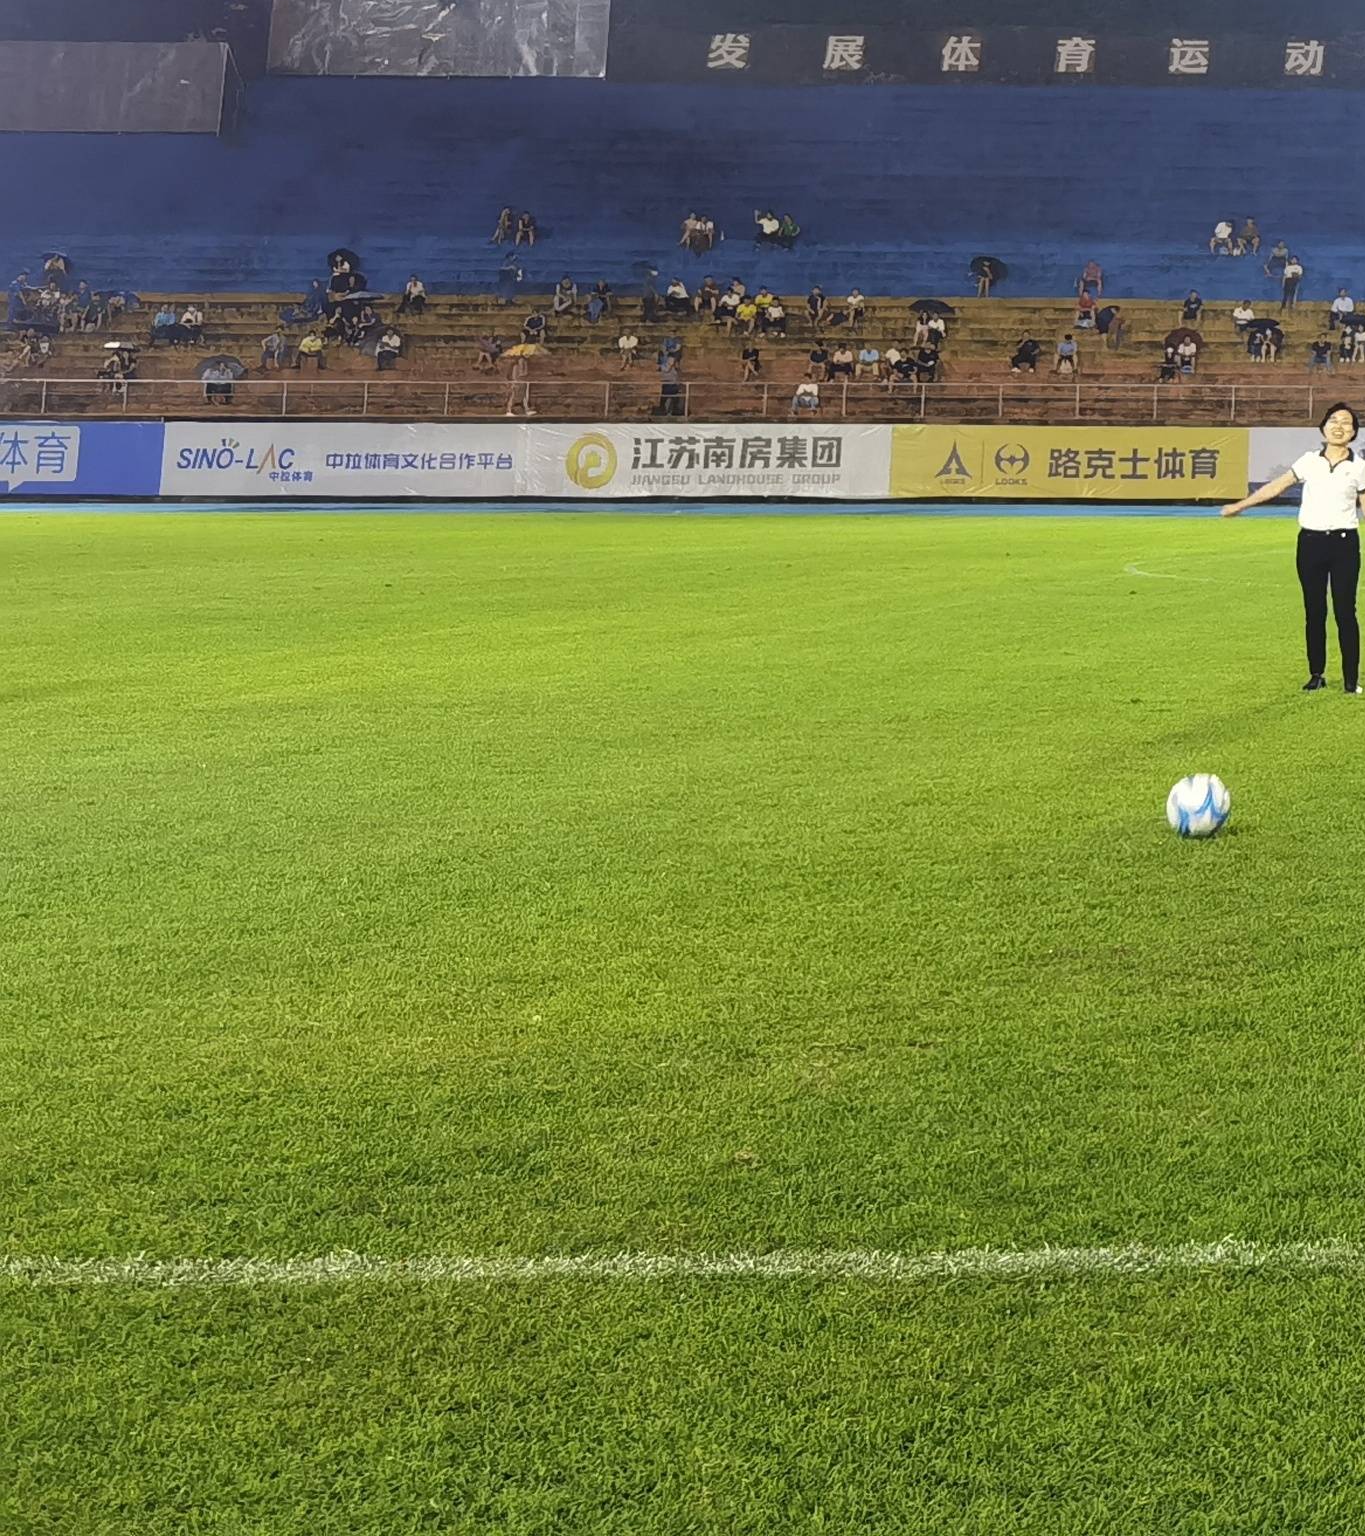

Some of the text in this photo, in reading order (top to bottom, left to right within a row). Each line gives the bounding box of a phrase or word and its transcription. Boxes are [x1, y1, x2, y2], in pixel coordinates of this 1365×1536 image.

[0, 430, 71, 474] 体育
[176, 445, 296, 474] SINO-LAC
[325, 451, 513, 470] 中拉体育文化合作平台
[632, 436, 842, 469] 江苏南房集团
[1048, 447, 1220, 480] 路克士体育
[792, 473, 841, 485] GROUP
